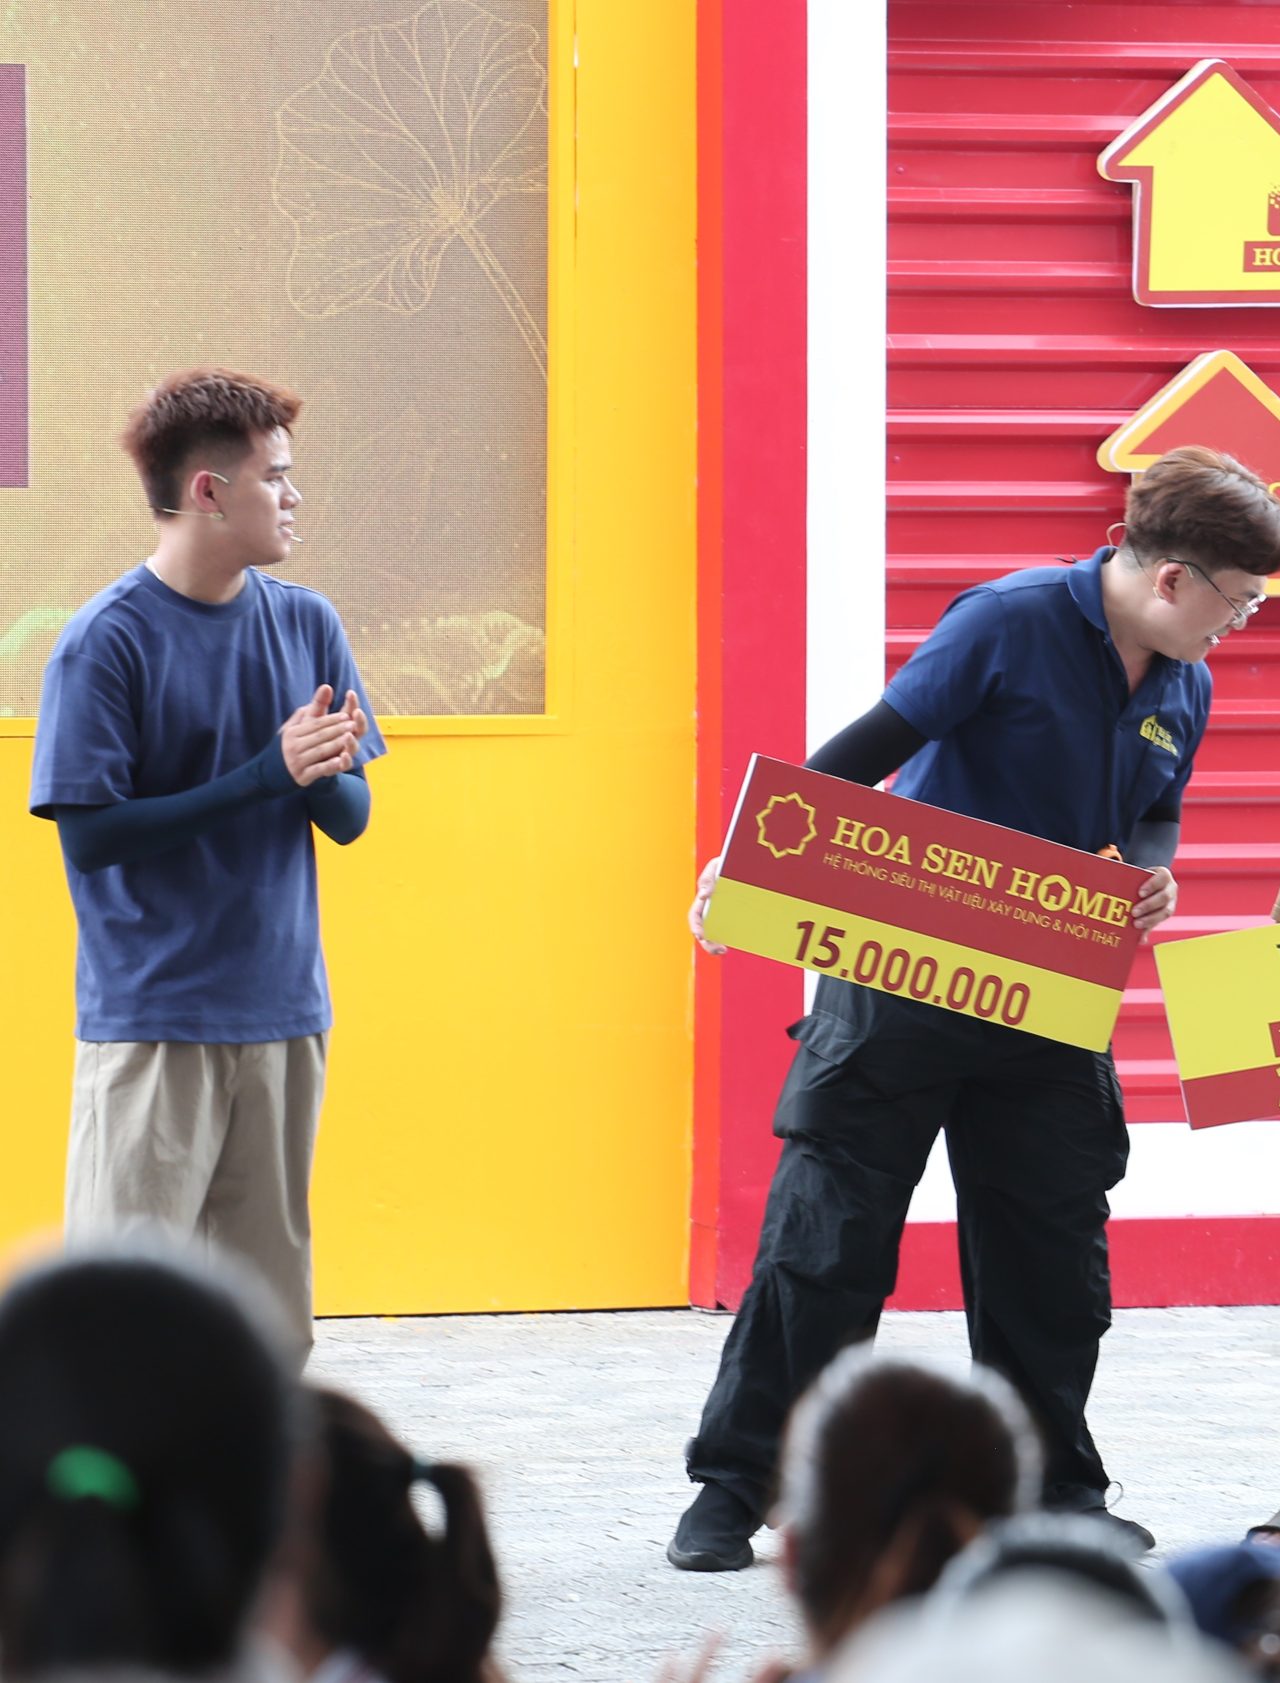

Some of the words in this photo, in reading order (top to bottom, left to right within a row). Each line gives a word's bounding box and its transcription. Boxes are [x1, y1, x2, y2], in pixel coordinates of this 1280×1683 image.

[822, 852, 843, 870] HỆ
[843, 858, 889, 881] THỐNG
[889, 871, 916, 889] SIÊU
[918, 879, 938, 898] THỊ
[938, 886, 963, 903] VẬT
[987, 899, 1014, 917] XÂY
[1052, 919, 1063, 932] &
[1064, 922, 1090, 940] NỘI
[830, 816, 912, 866] HOA
[921, 843, 1003, 889] SEN
[1005, 867, 1133, 928] HOME
[794, 919, 1031, 1026] 15.000.000
